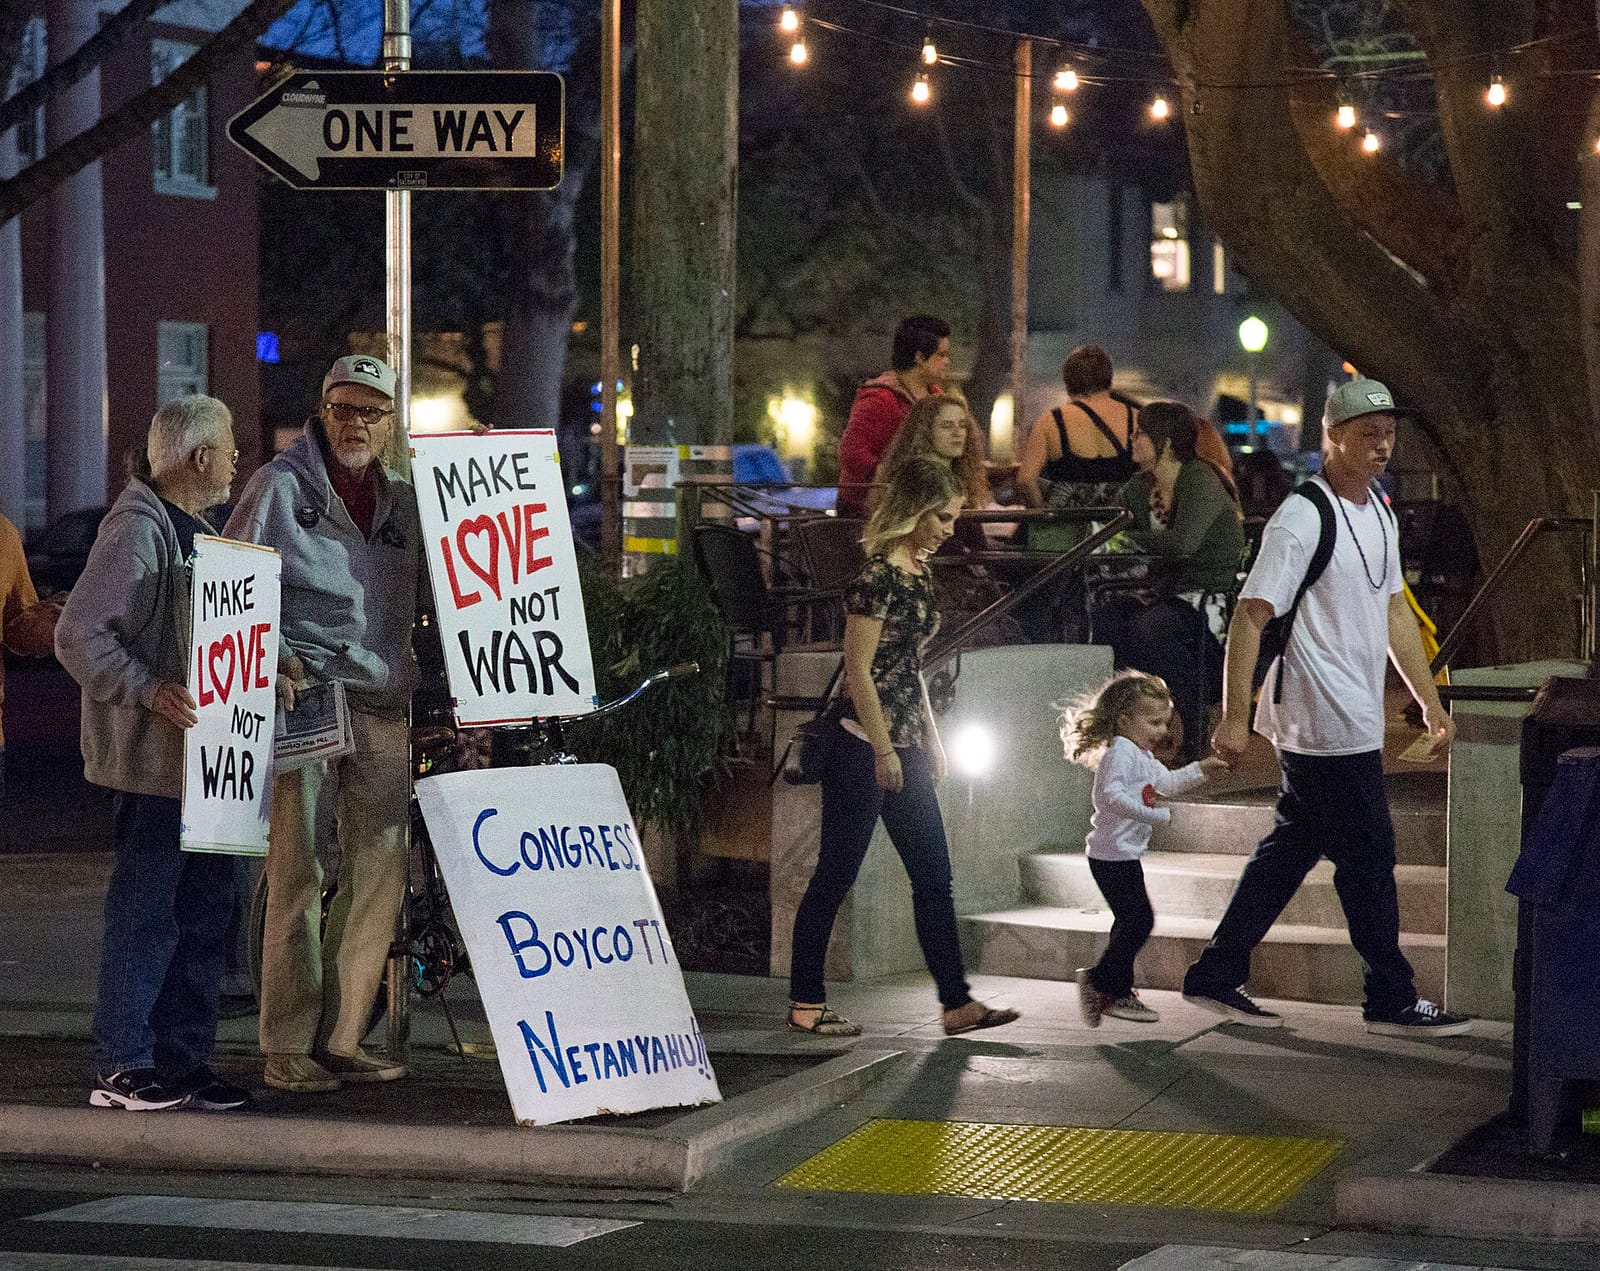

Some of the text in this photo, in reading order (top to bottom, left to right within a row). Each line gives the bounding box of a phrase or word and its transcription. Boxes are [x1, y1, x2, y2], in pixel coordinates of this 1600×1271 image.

[323, 109, 525, 152] ONE WAY
[433, 452, 536, 522] MAKE
[202, 574, 255, 621] MAKE
[510, 586, 560, 626] NOT
[458, 630, 580, 697] WAR
[230, 704, 266, 743] NOT
[200, 745, 255, 801] WAR
[496, 910, 669, 979] BOYCOTT
[516, 1010, 712, 1094] NETANYAHU!!
